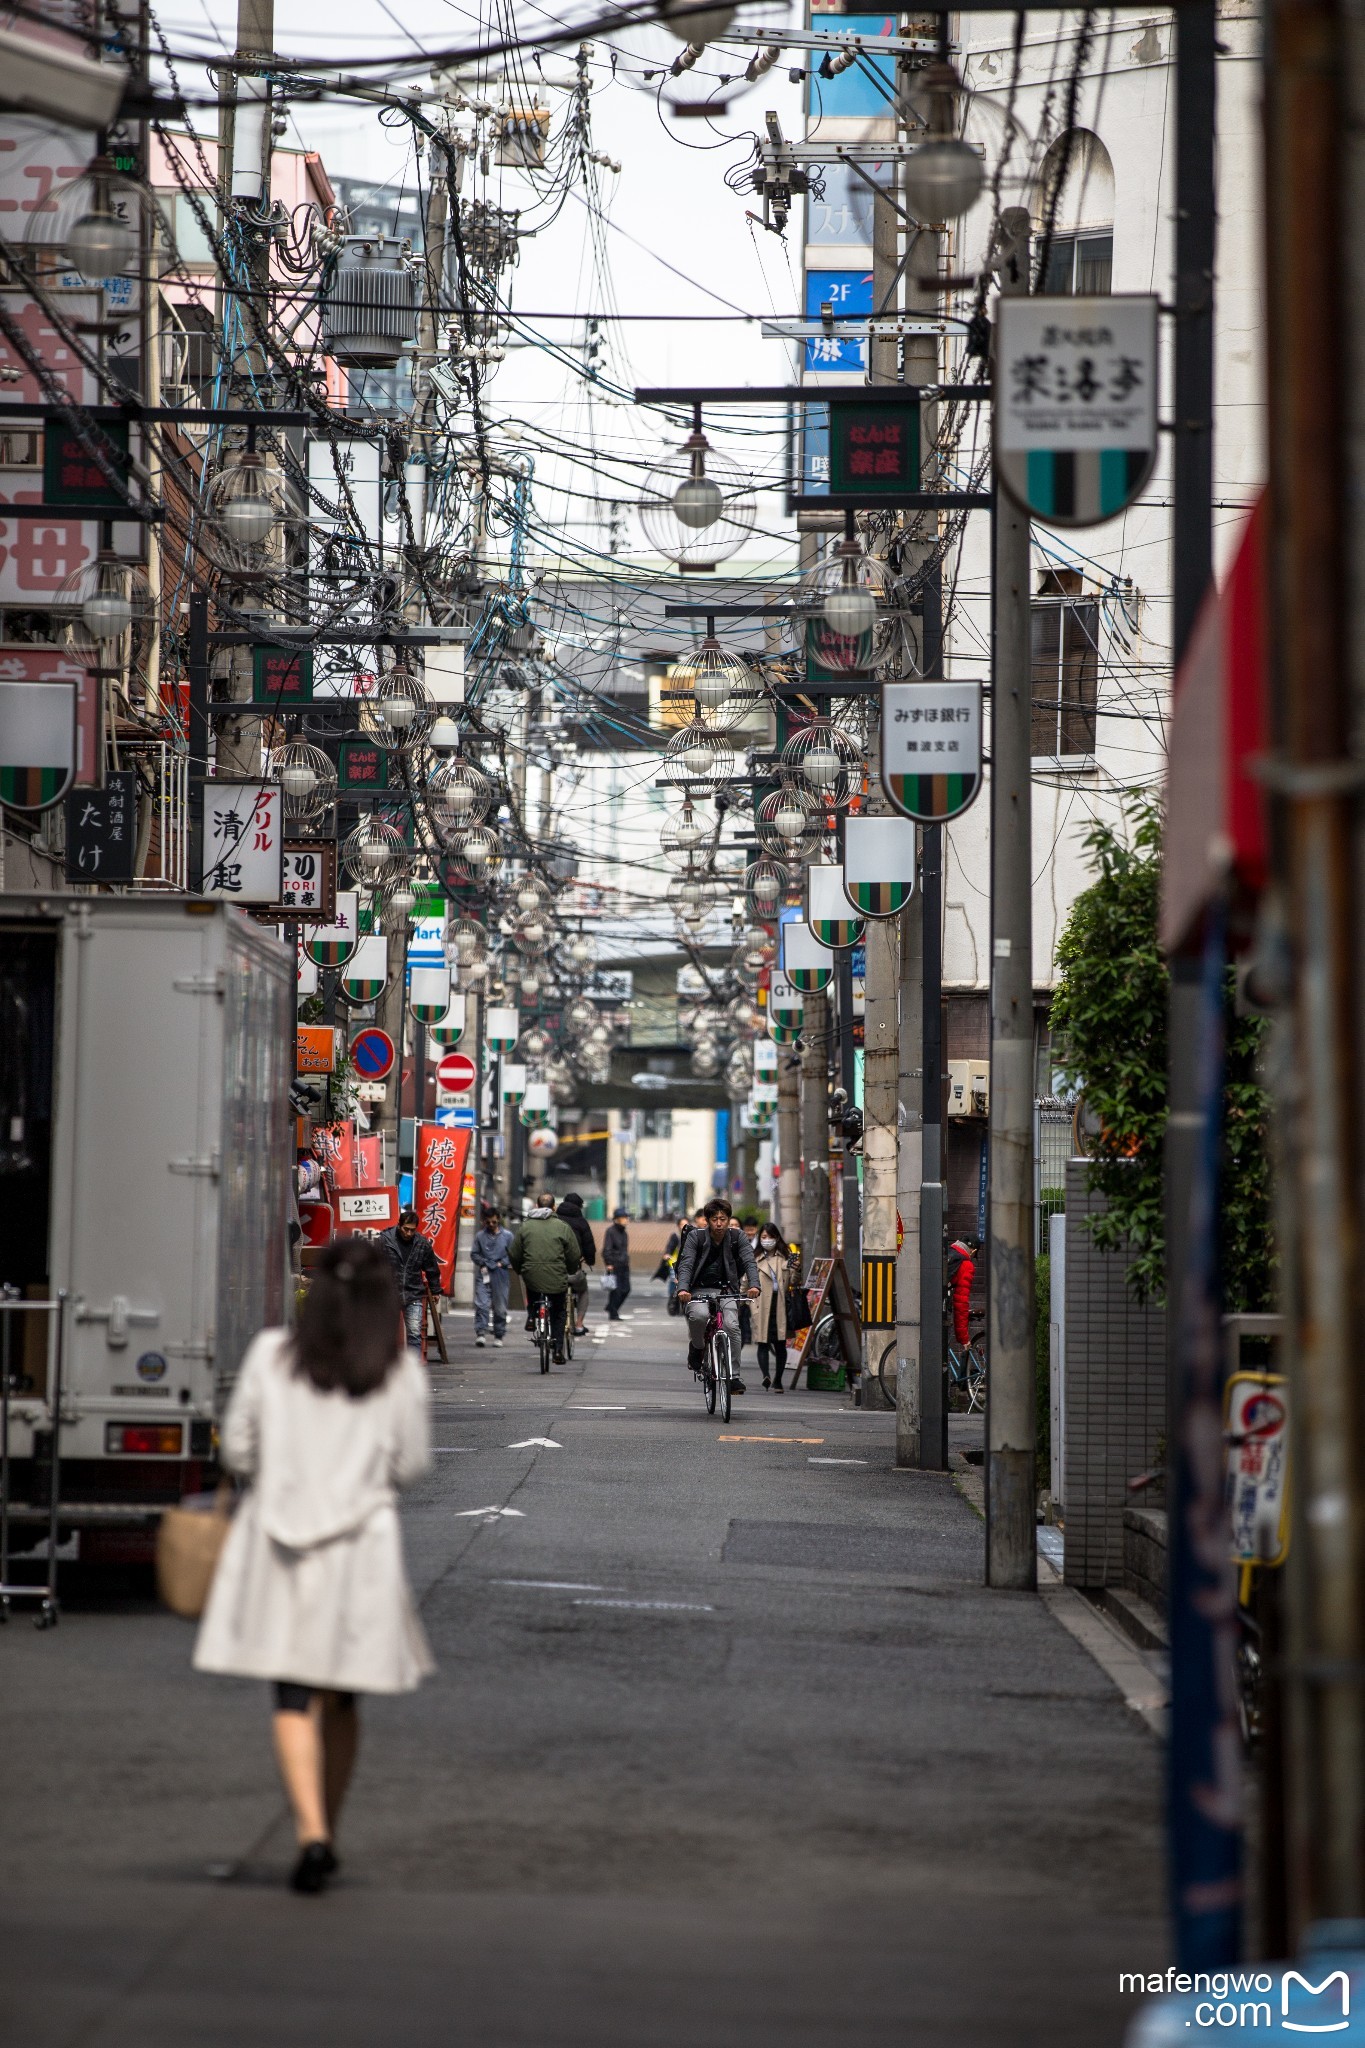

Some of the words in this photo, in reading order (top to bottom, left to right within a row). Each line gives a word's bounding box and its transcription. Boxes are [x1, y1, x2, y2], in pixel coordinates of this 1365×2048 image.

[829, 284, 851, 301] 2F
[894, 708, 971, 723] みずほ銀行
[79, 801, 103, 872] たけ
[108, 779, 125, 841] 焼酎酒屋
[253, 791, 277, 852] グリル
[210, 809, 244, 892] 清起
[302, 1057, 329, 1068] あそう
